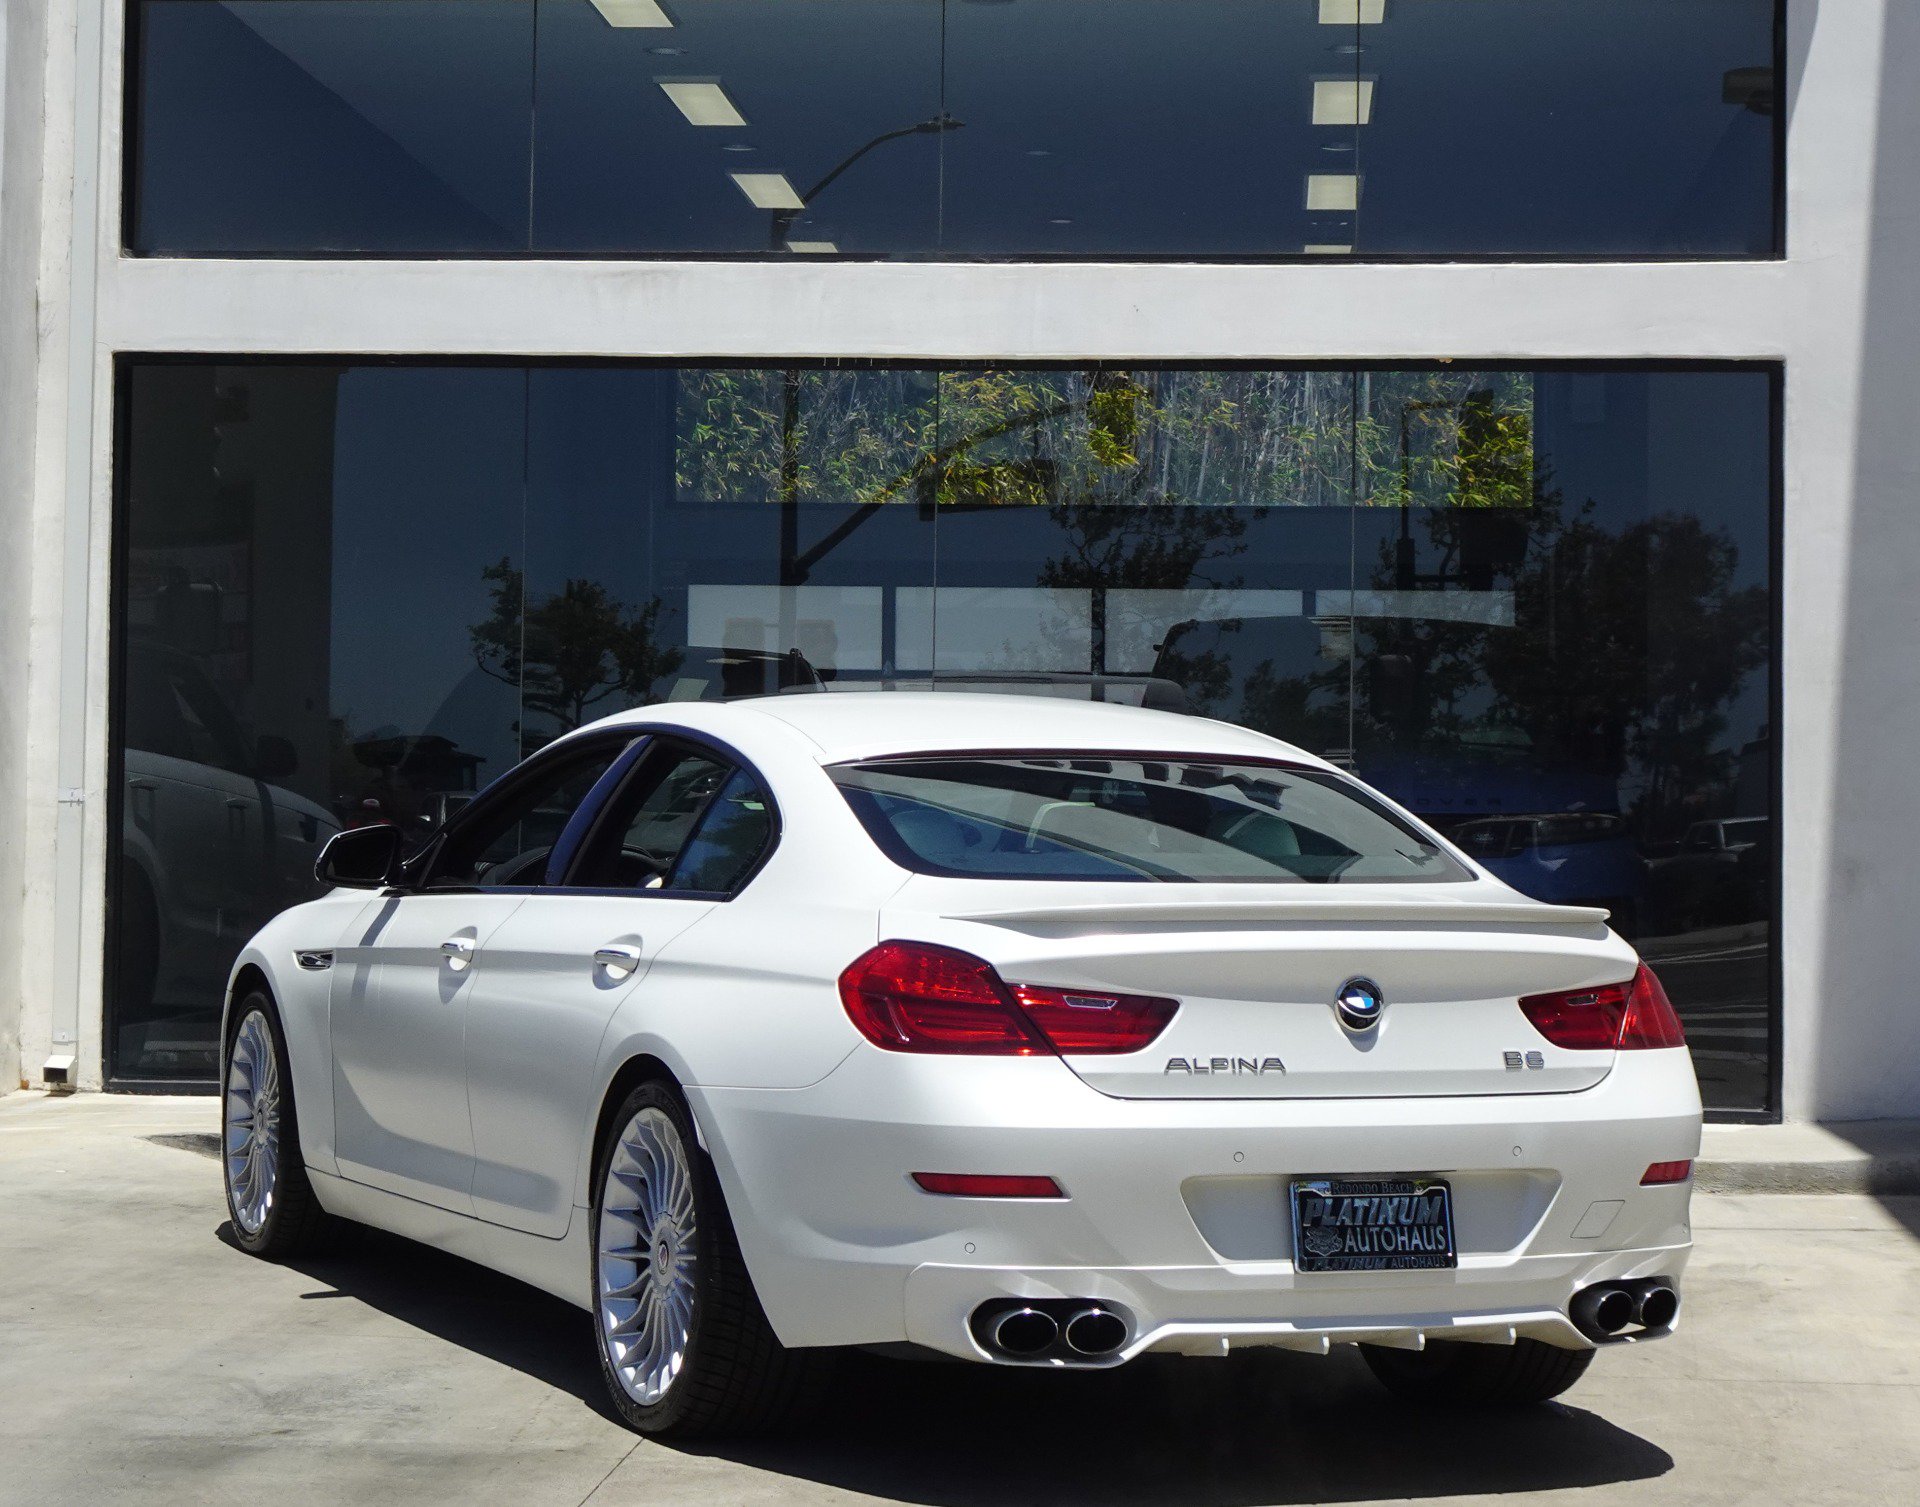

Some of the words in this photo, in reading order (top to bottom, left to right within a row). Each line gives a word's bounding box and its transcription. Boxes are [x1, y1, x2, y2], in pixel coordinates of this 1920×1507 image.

[1164, 1057, 1287, 1077] ALPINA
[1503, 1051, 1544, 1071] B6
[1302, 1197, 1442, 1226] PLATINUM
[1345, 1226, 1447, 1252] AUTOHAUS
[1391, 1256, 1446, 1269] AUTOHAUS
